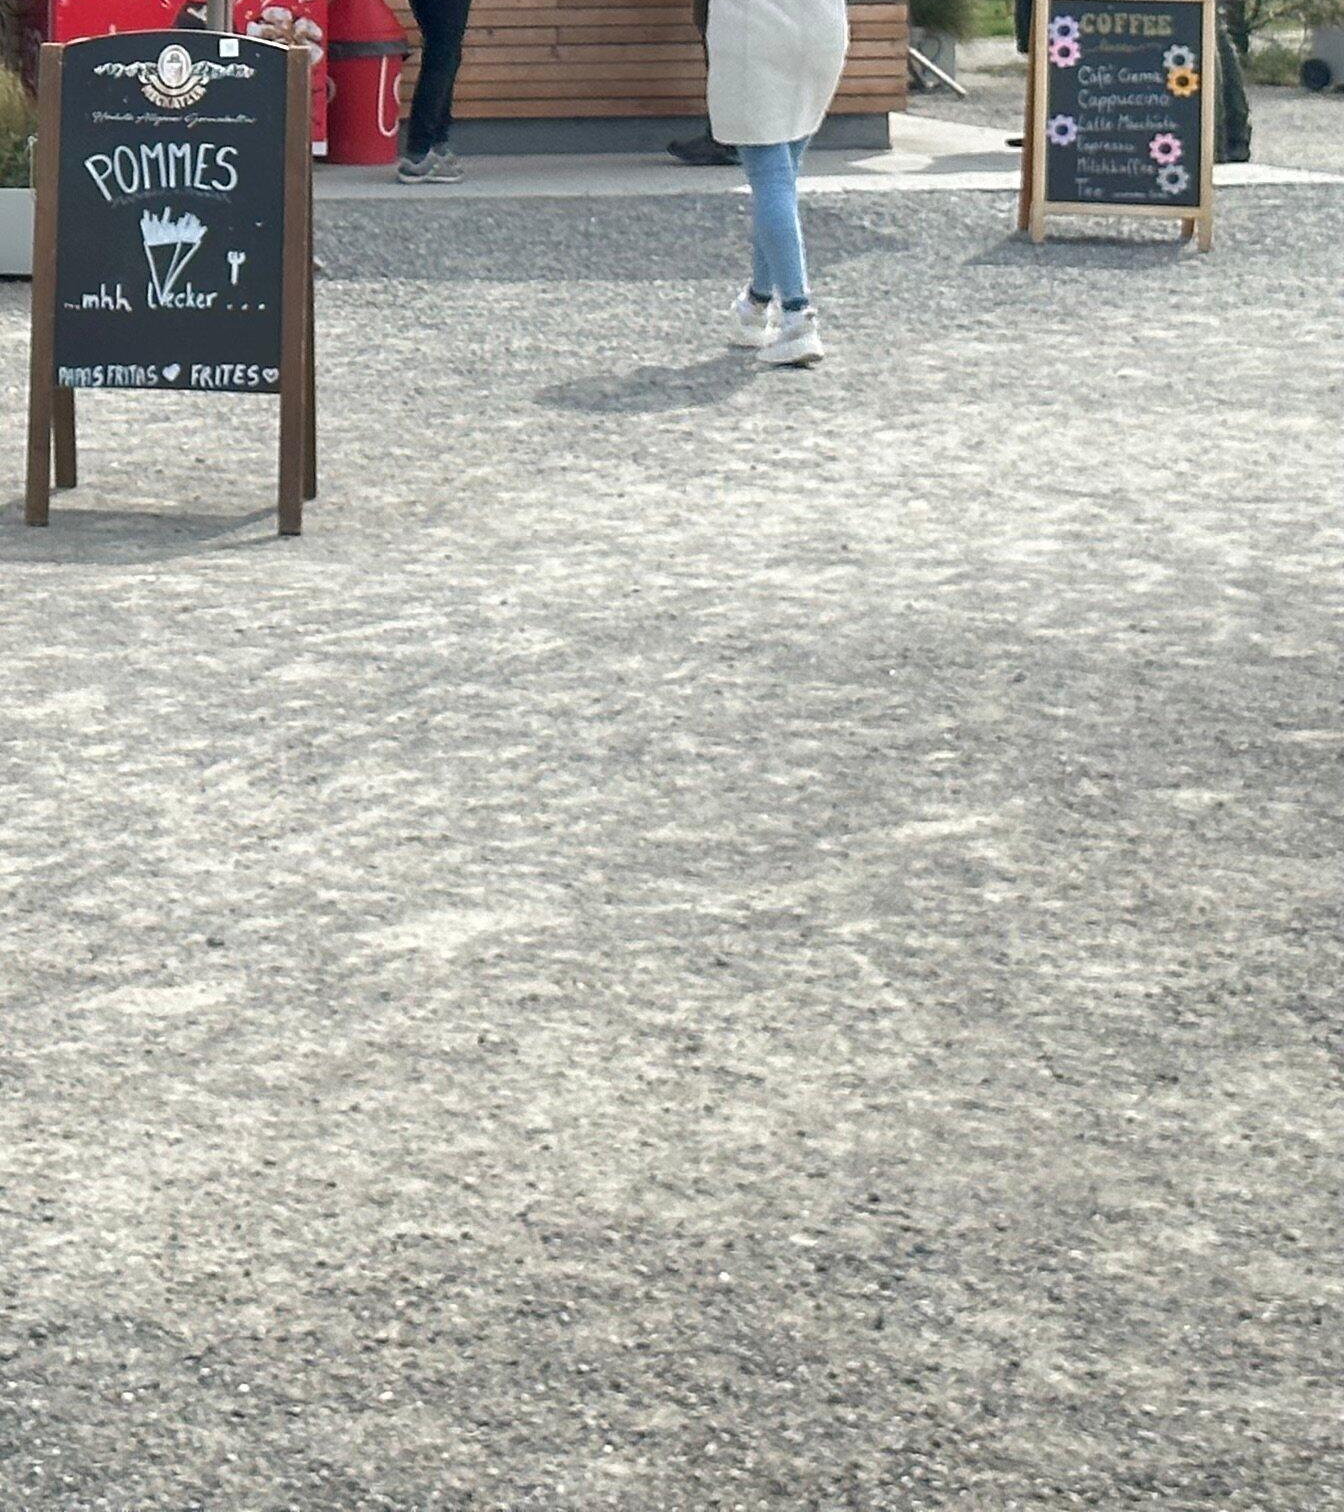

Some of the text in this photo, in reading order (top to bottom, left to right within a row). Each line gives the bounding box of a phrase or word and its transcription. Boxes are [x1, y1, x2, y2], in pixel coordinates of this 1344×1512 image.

[1080, 12, 1173, 36] COFFEE
[1077, 89, 1170, 113] Cappuccino
[84, 142, 239, 201] POMMES
[191, 363, 260, 387] FRITES
